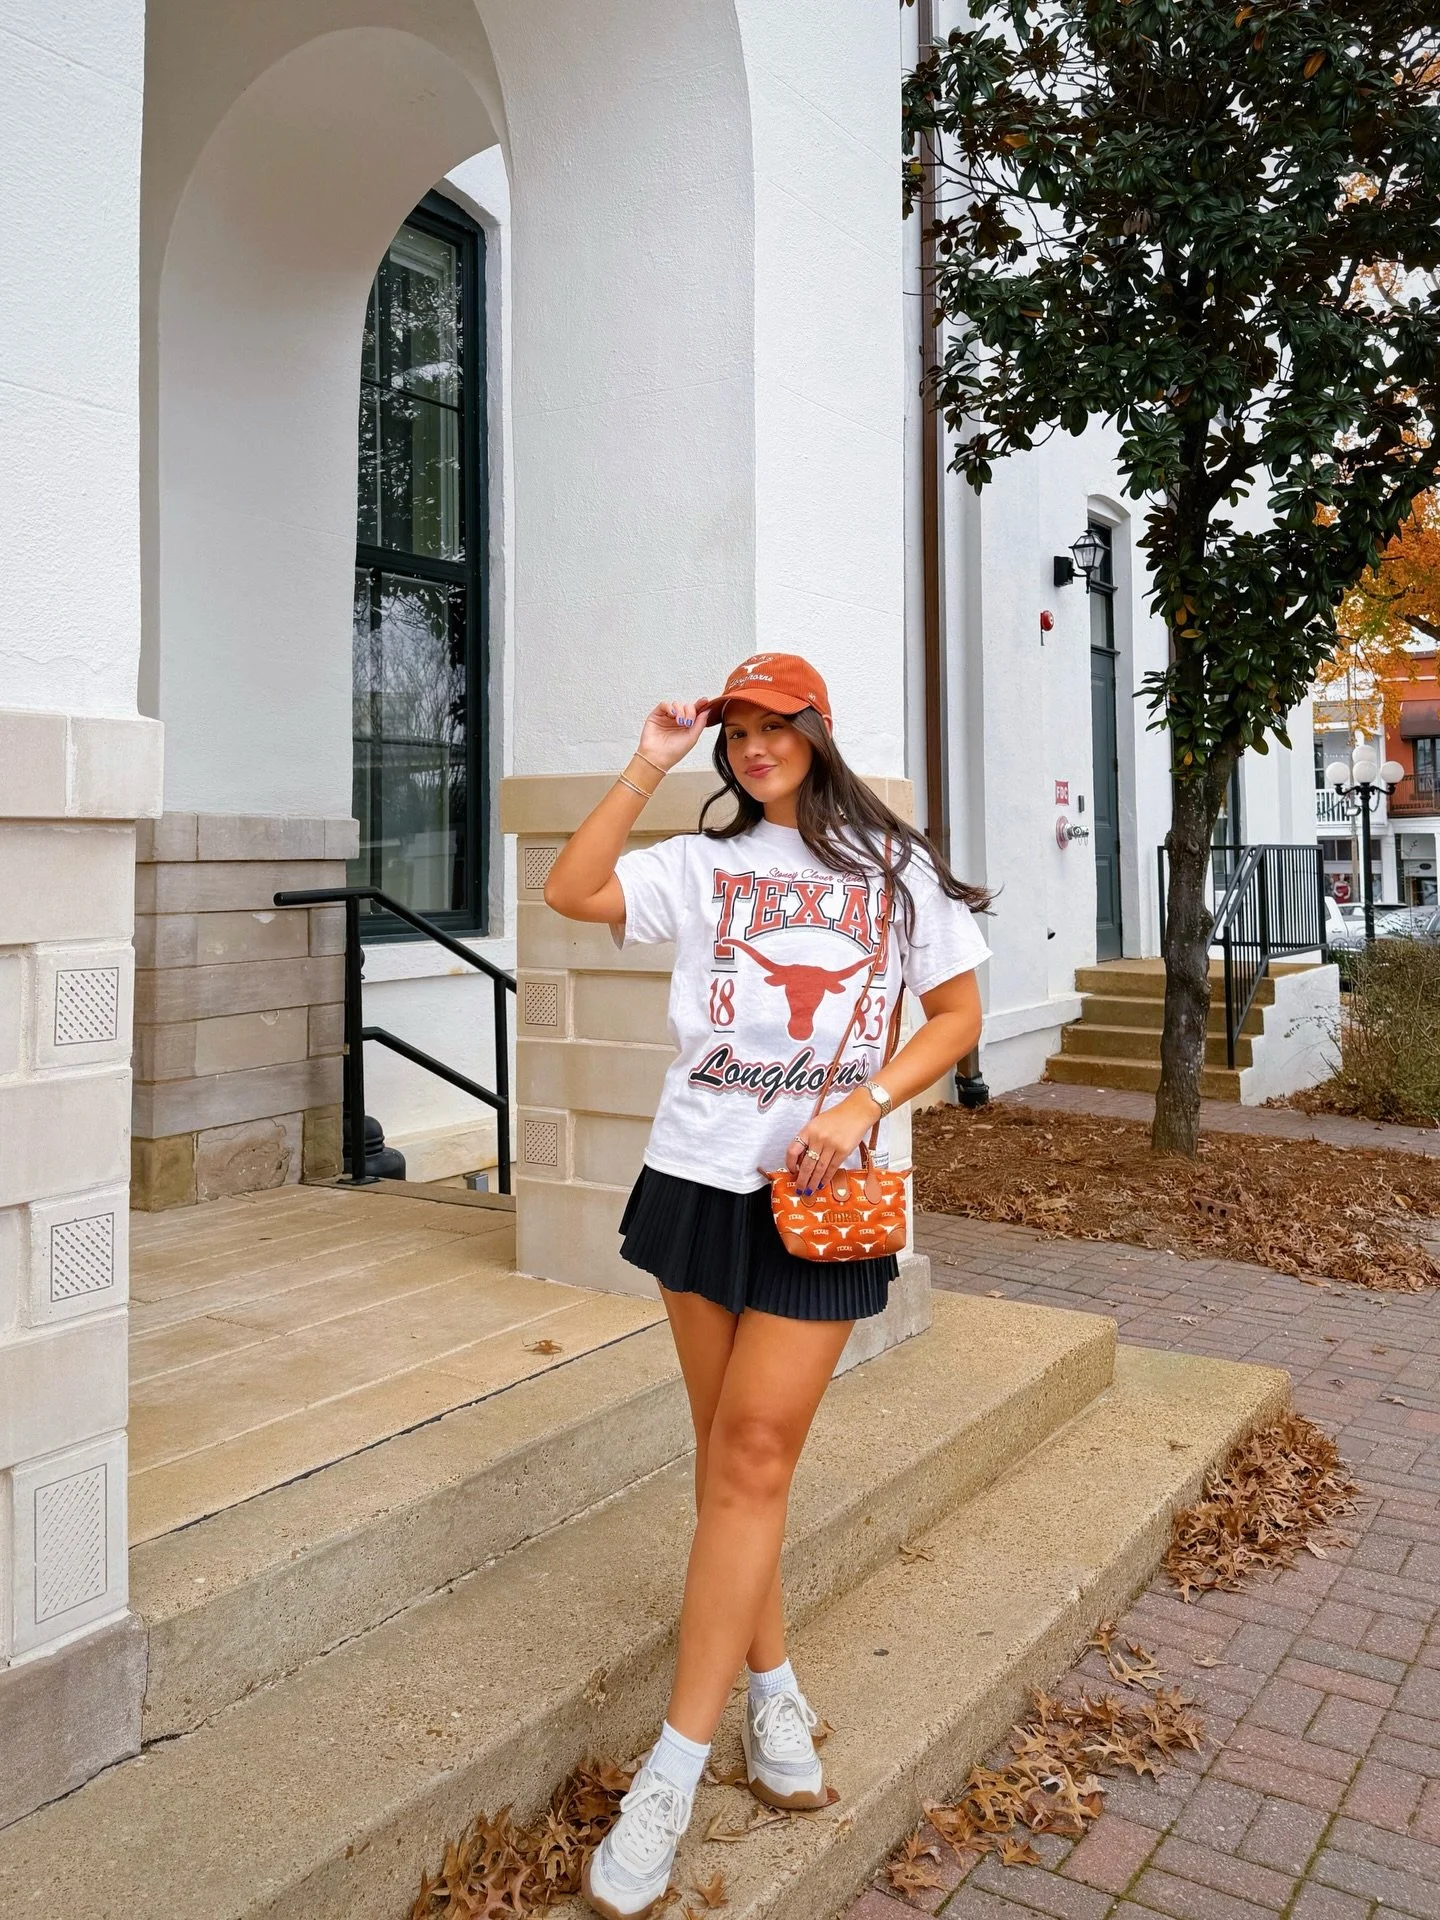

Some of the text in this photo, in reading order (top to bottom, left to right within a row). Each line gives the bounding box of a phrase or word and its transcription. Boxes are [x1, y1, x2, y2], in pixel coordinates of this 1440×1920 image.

[1056, 786, 1068, 799] FDC
[767, 868, 798, 881] Stoney
[801, 869, 834, 881] Clover
[710, 978, 735, 1027] 18
